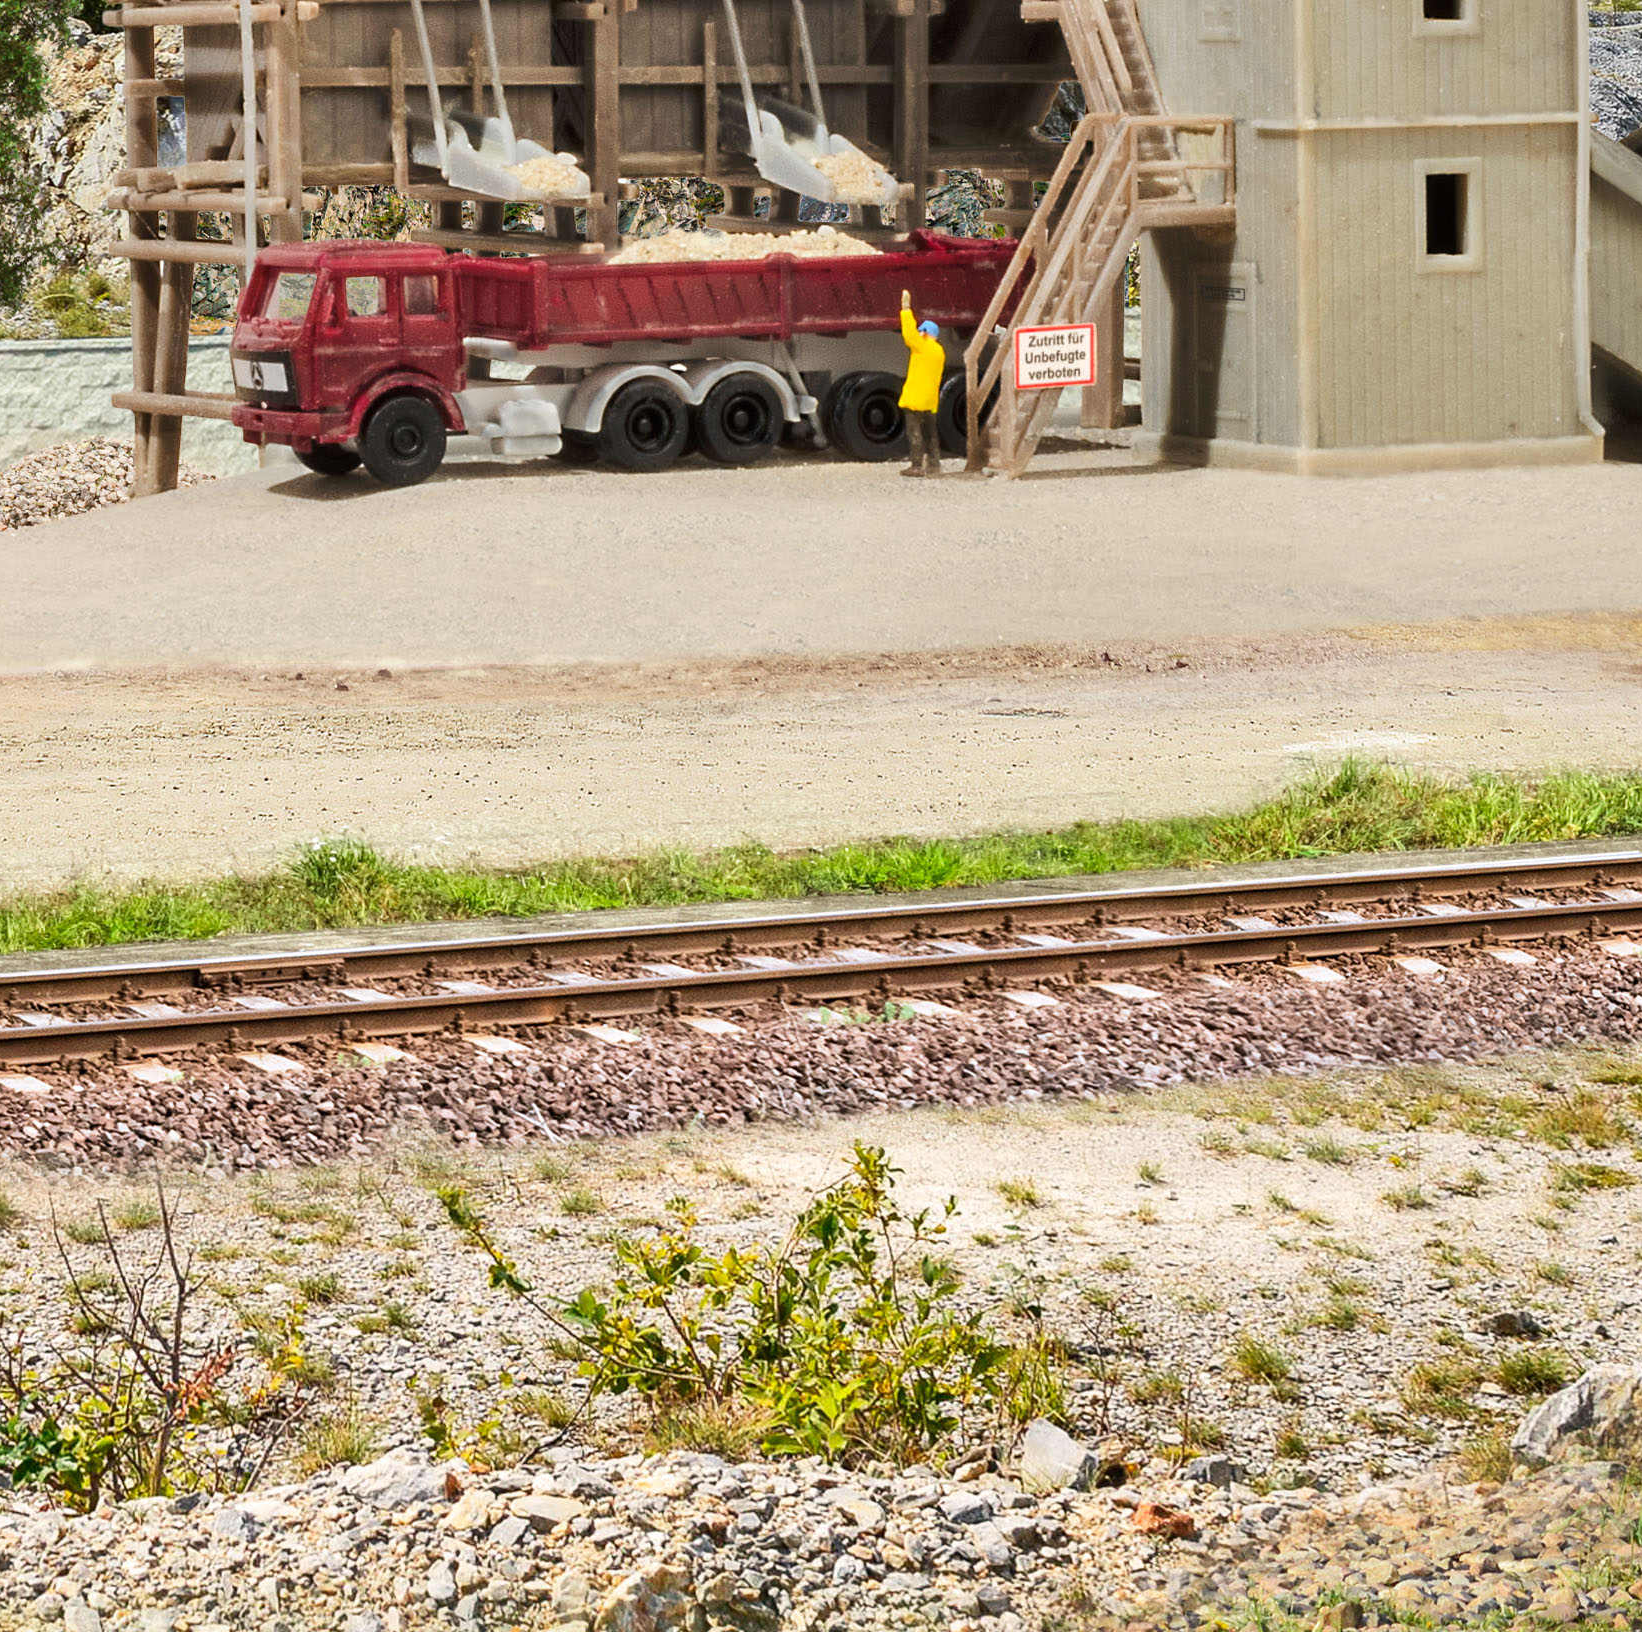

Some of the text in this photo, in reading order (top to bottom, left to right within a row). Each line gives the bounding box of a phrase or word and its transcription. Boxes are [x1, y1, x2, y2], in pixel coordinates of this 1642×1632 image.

[1028, 332, 1084, 347] Zutritt für
[1025, 350, 1086, 364] Unbefugte
[1029, 367, 1081, 380] verboten
